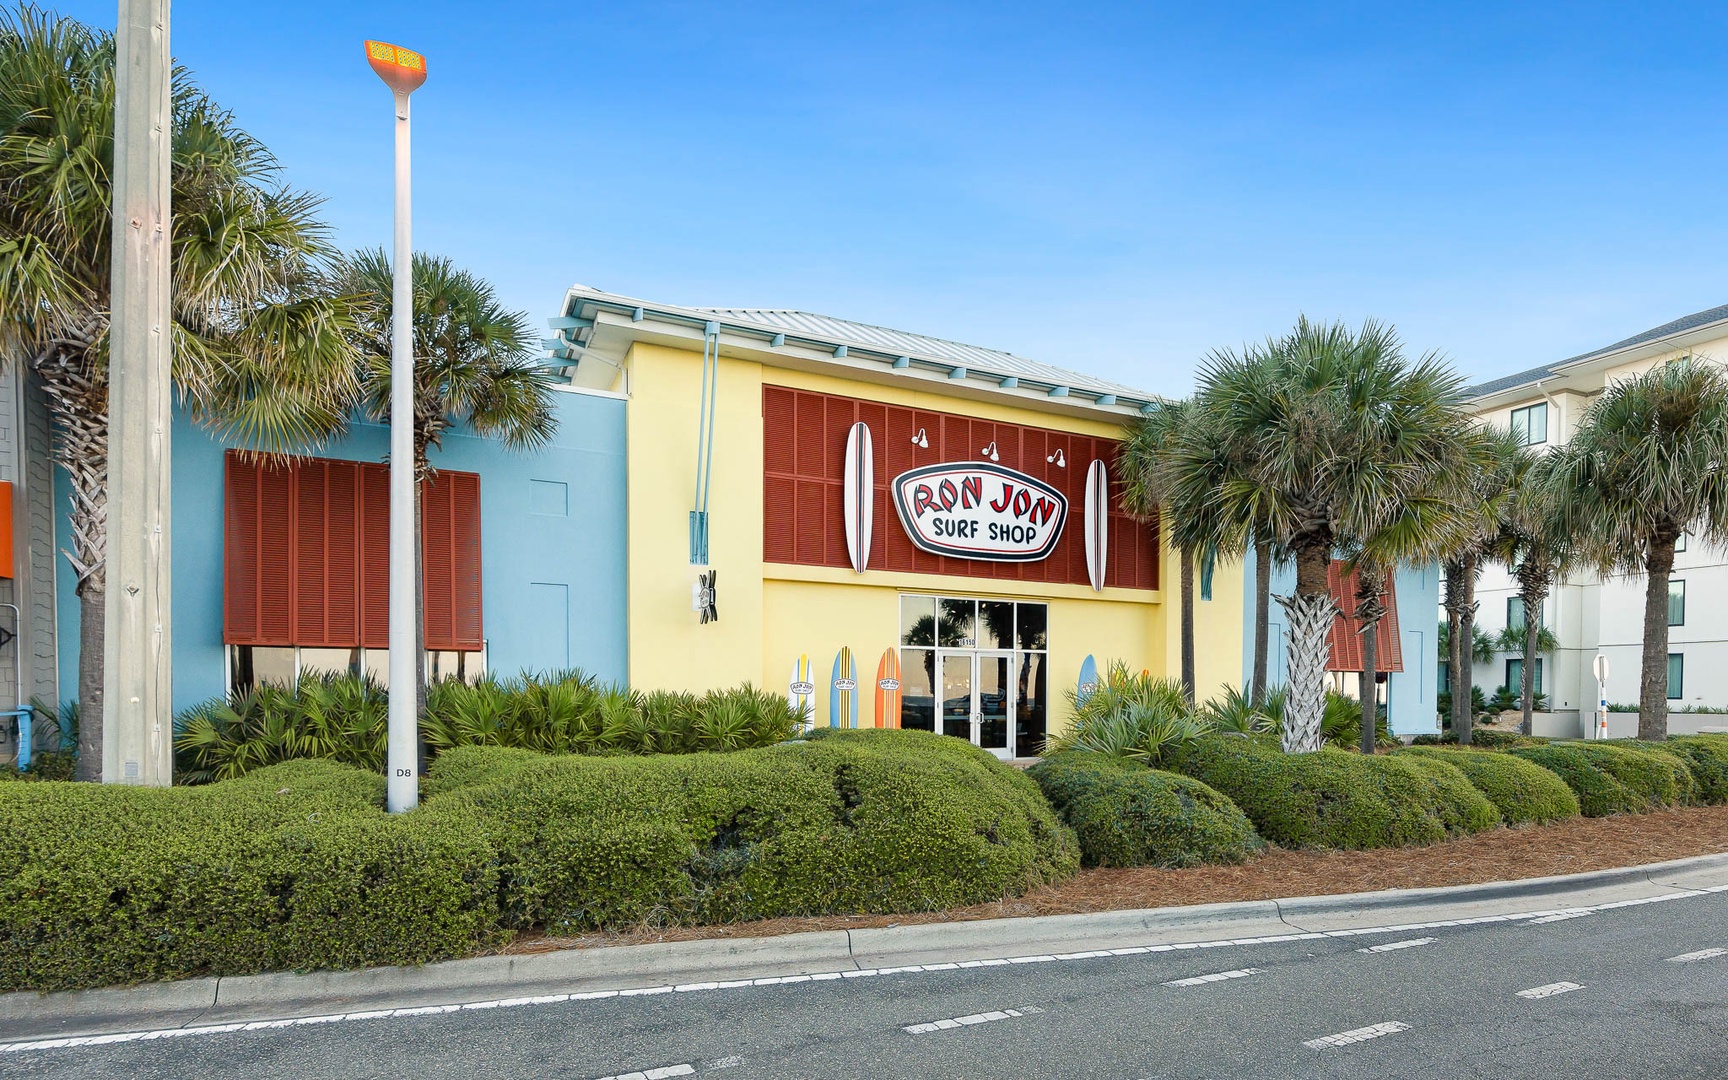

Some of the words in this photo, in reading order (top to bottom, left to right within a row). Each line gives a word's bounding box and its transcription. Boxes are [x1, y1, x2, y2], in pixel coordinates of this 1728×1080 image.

[914, 476, 982, 519] RON
[990, 482, 1056, 527] JON
[932, 517, 979, 539] SURF
[988, 522, 1037, 545] SHOP
[396, 768, 411, 777] D8
